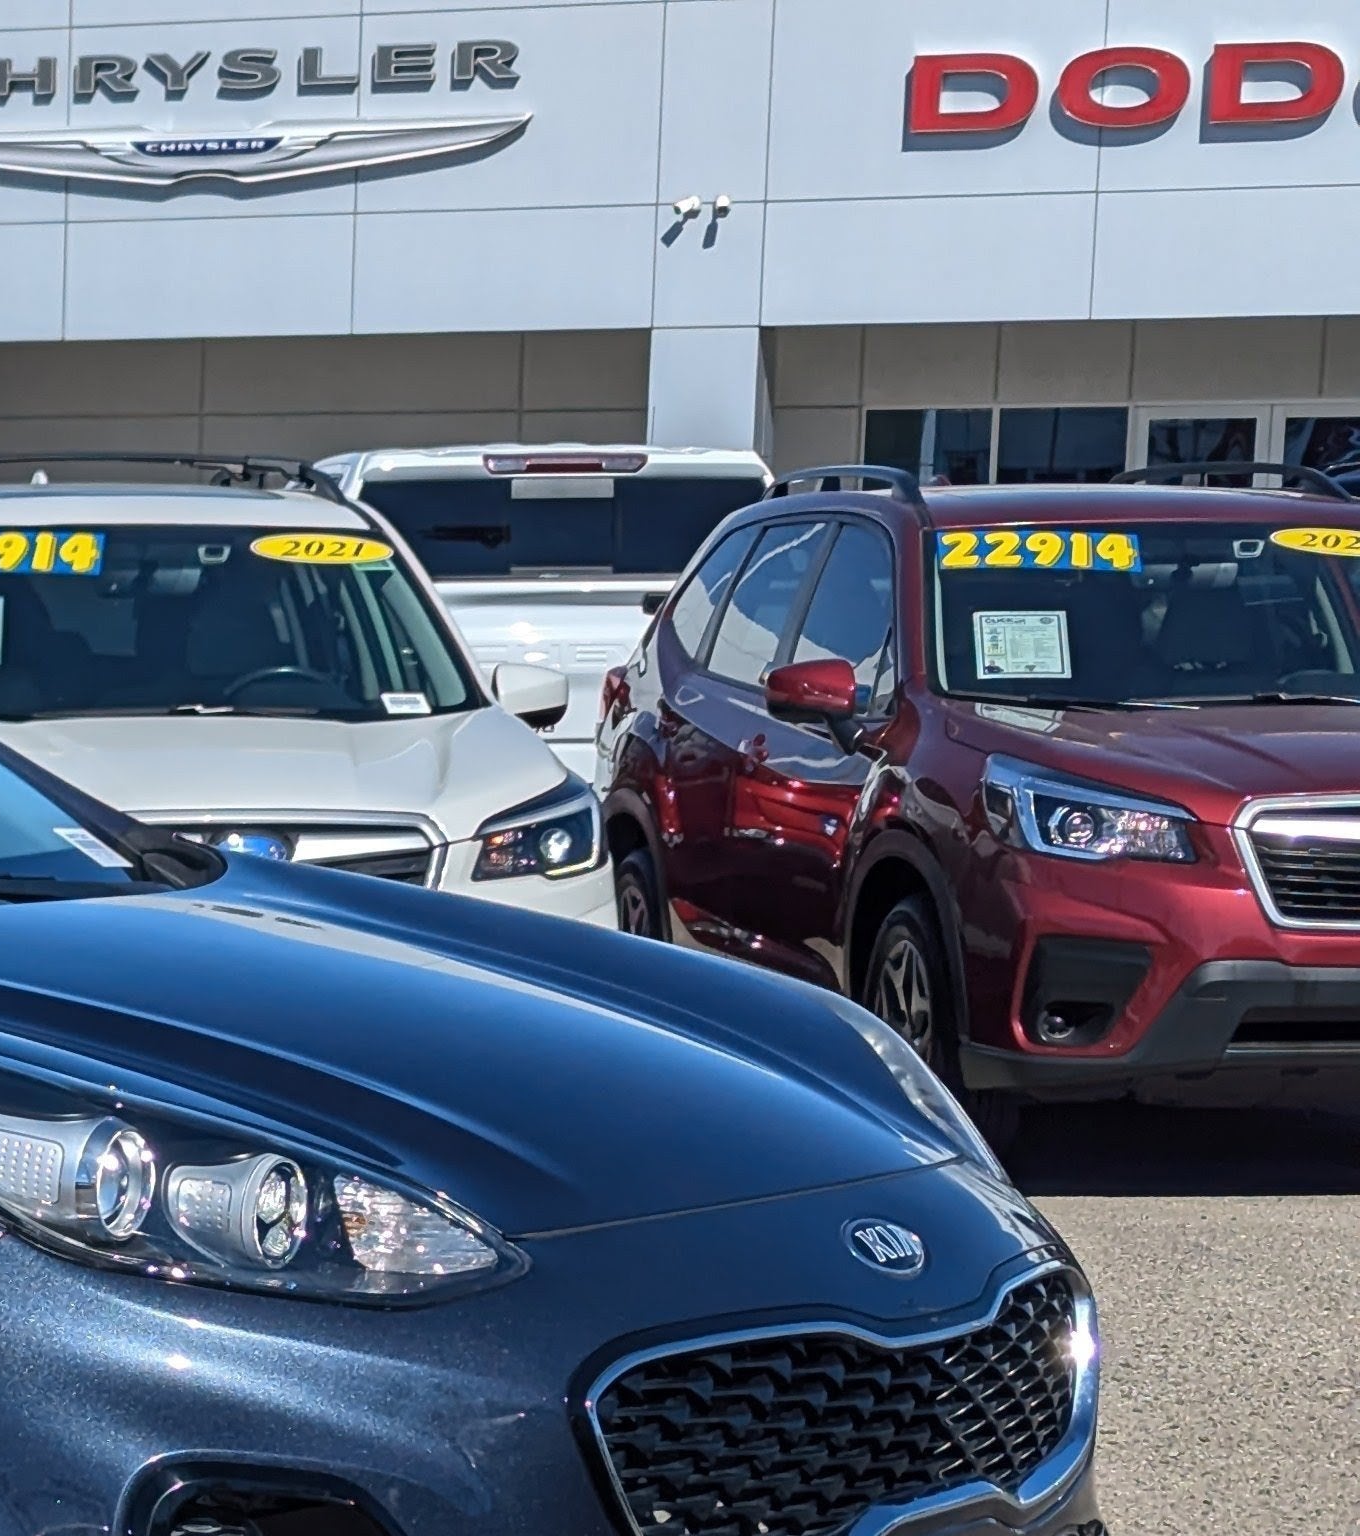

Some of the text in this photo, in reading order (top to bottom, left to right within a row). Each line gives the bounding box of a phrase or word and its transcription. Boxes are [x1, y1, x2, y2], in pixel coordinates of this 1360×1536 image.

[145, 140, 266, 153] CHRYSLER
[281, 540, 366, 557] 2021
[941, 531, 1137, 569] 22914
[855, 1225, 922, 1263] KIA
